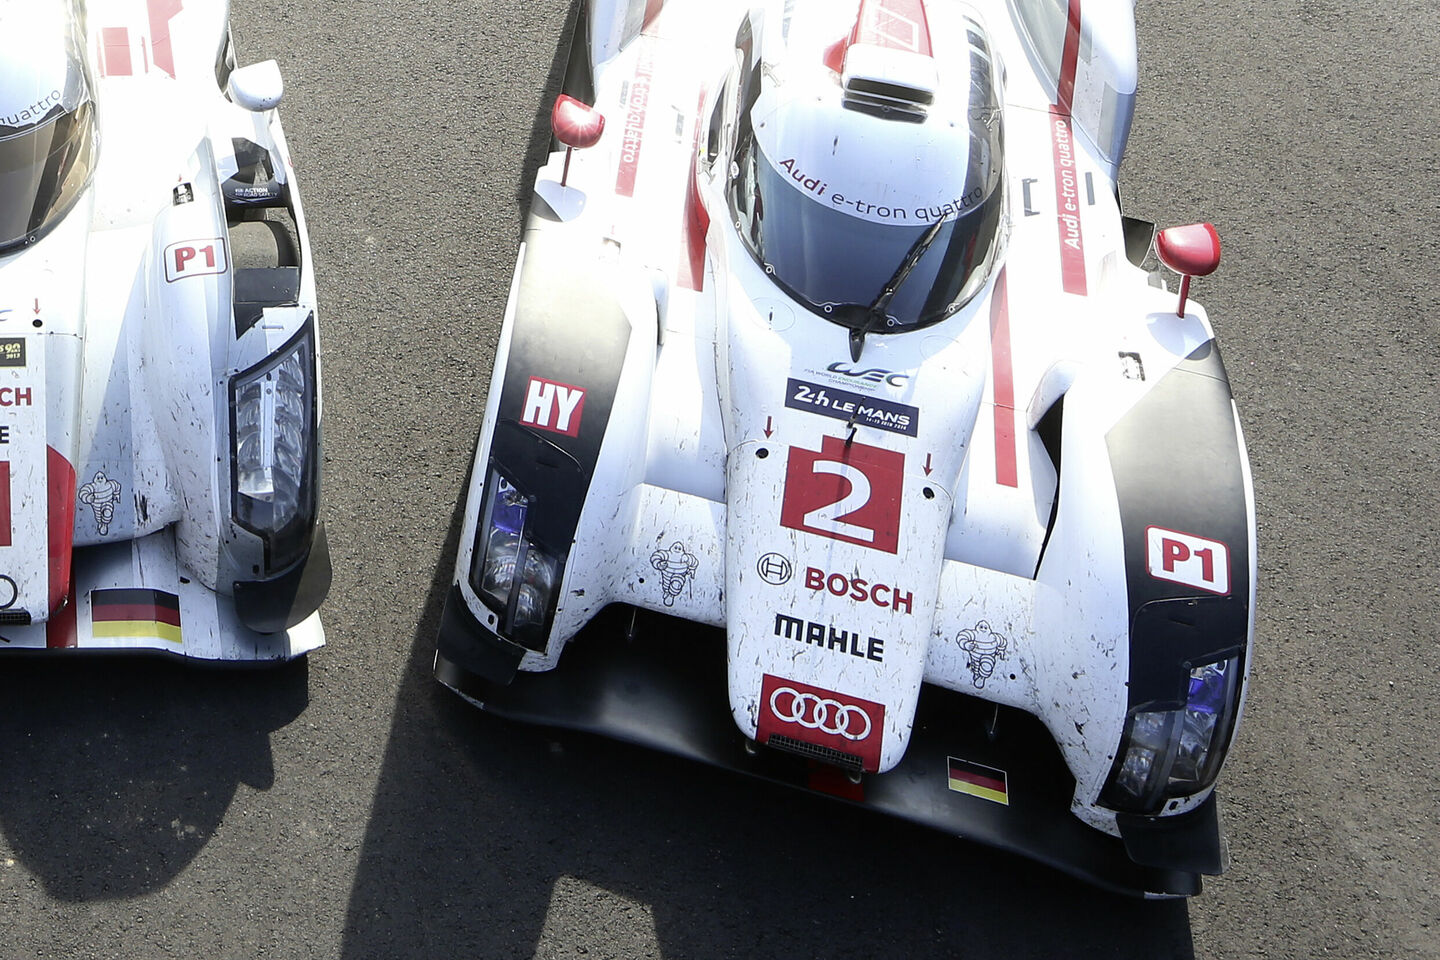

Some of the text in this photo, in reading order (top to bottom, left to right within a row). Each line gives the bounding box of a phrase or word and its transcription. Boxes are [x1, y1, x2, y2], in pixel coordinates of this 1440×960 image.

[779, 157, 983, 222] Audi e-tron quattro
[1058, 119, 1082, 250] Audi e-tron quattro
[173, 245, 217, 273] P1
[815, 371, 838, 380] WORLD
[838, 376, 877, 389] ENDURANCE
[826, 361, 910, 388] WEC
[828, 378, 876, 392] CHAMPIONSHIP
[522, 379, 584, 432] HY
[832, 401, 856, 413] LE
[857, 405, 910, 426] MANS
[803, 459, 874, 543] 2
[1161, 537, 1215, 583] P1
[805, 566, 914, 615] BOSCH
[774, 613, 885, 663] MAHLE
